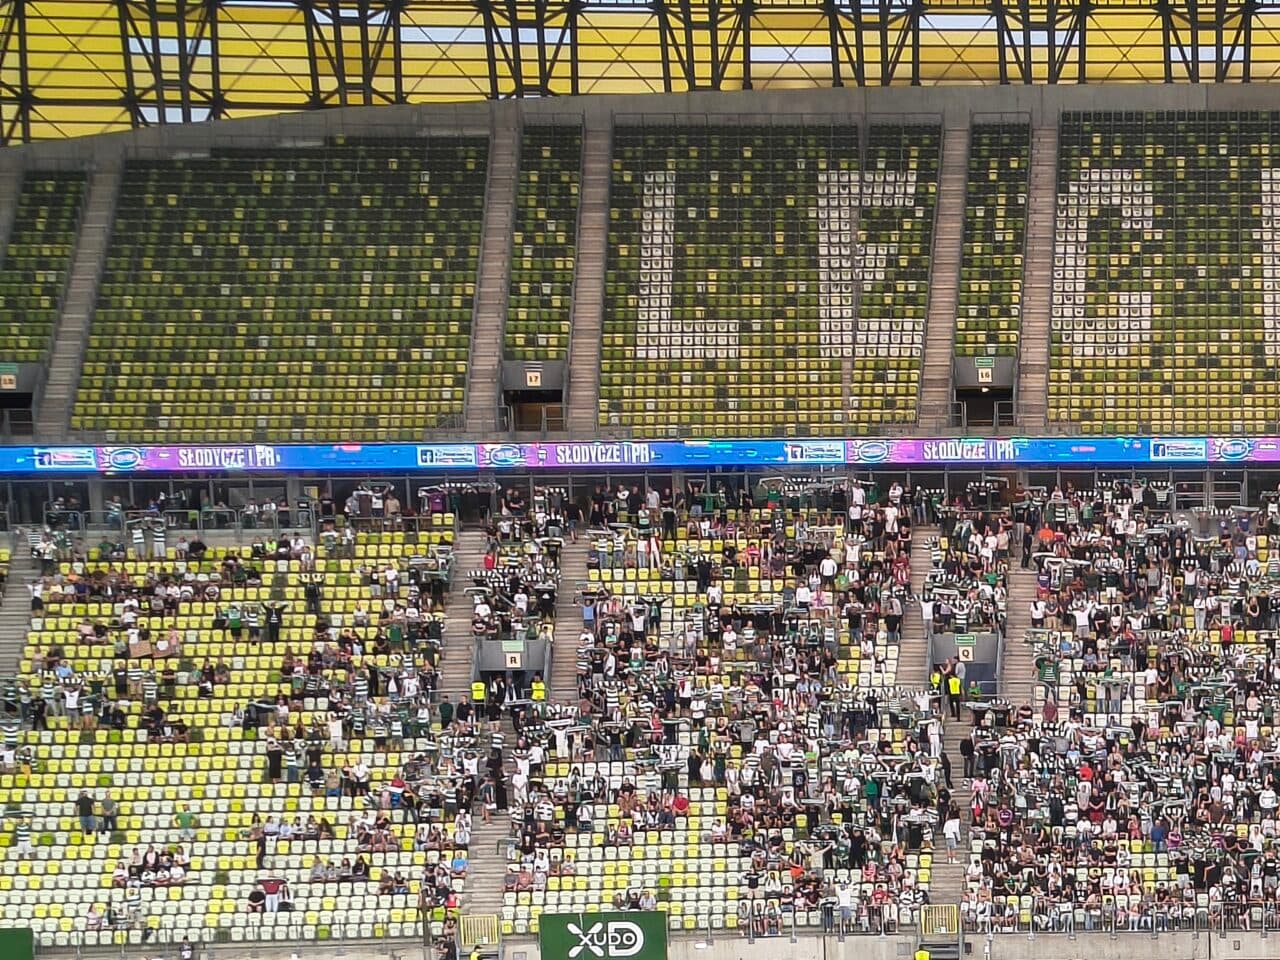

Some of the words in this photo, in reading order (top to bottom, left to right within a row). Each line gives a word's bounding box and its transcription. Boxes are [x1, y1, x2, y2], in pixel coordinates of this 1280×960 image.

[178, 448, 246, 467] SŁODYCZE
[556, 445, 621, 463] SŁODYCZE
[923, 441, 986, 459] SŁODYCZE
